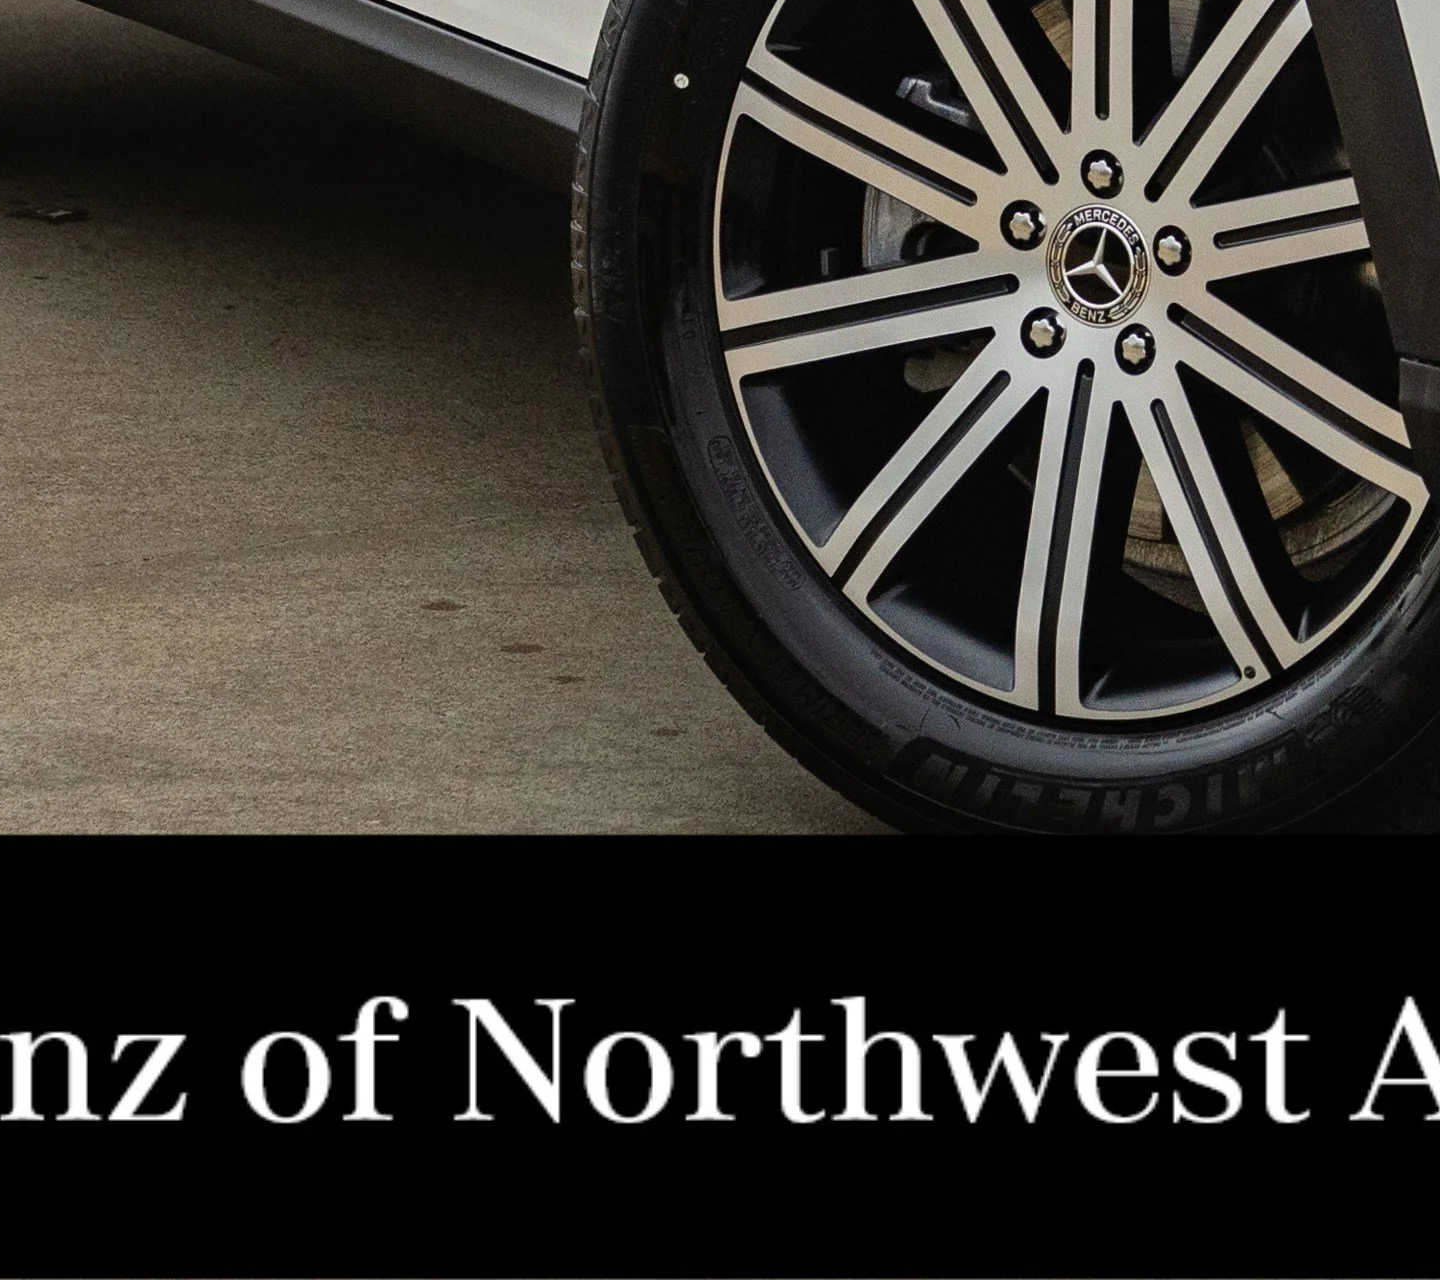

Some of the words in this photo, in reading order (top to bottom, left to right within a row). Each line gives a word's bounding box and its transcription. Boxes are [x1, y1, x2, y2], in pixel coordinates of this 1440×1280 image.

[1074, 209, 1139, 245] MERCEDES
[1071, 302, 1106, 322] BENZ
[912, 747, 1290, 835] MICHELIN
